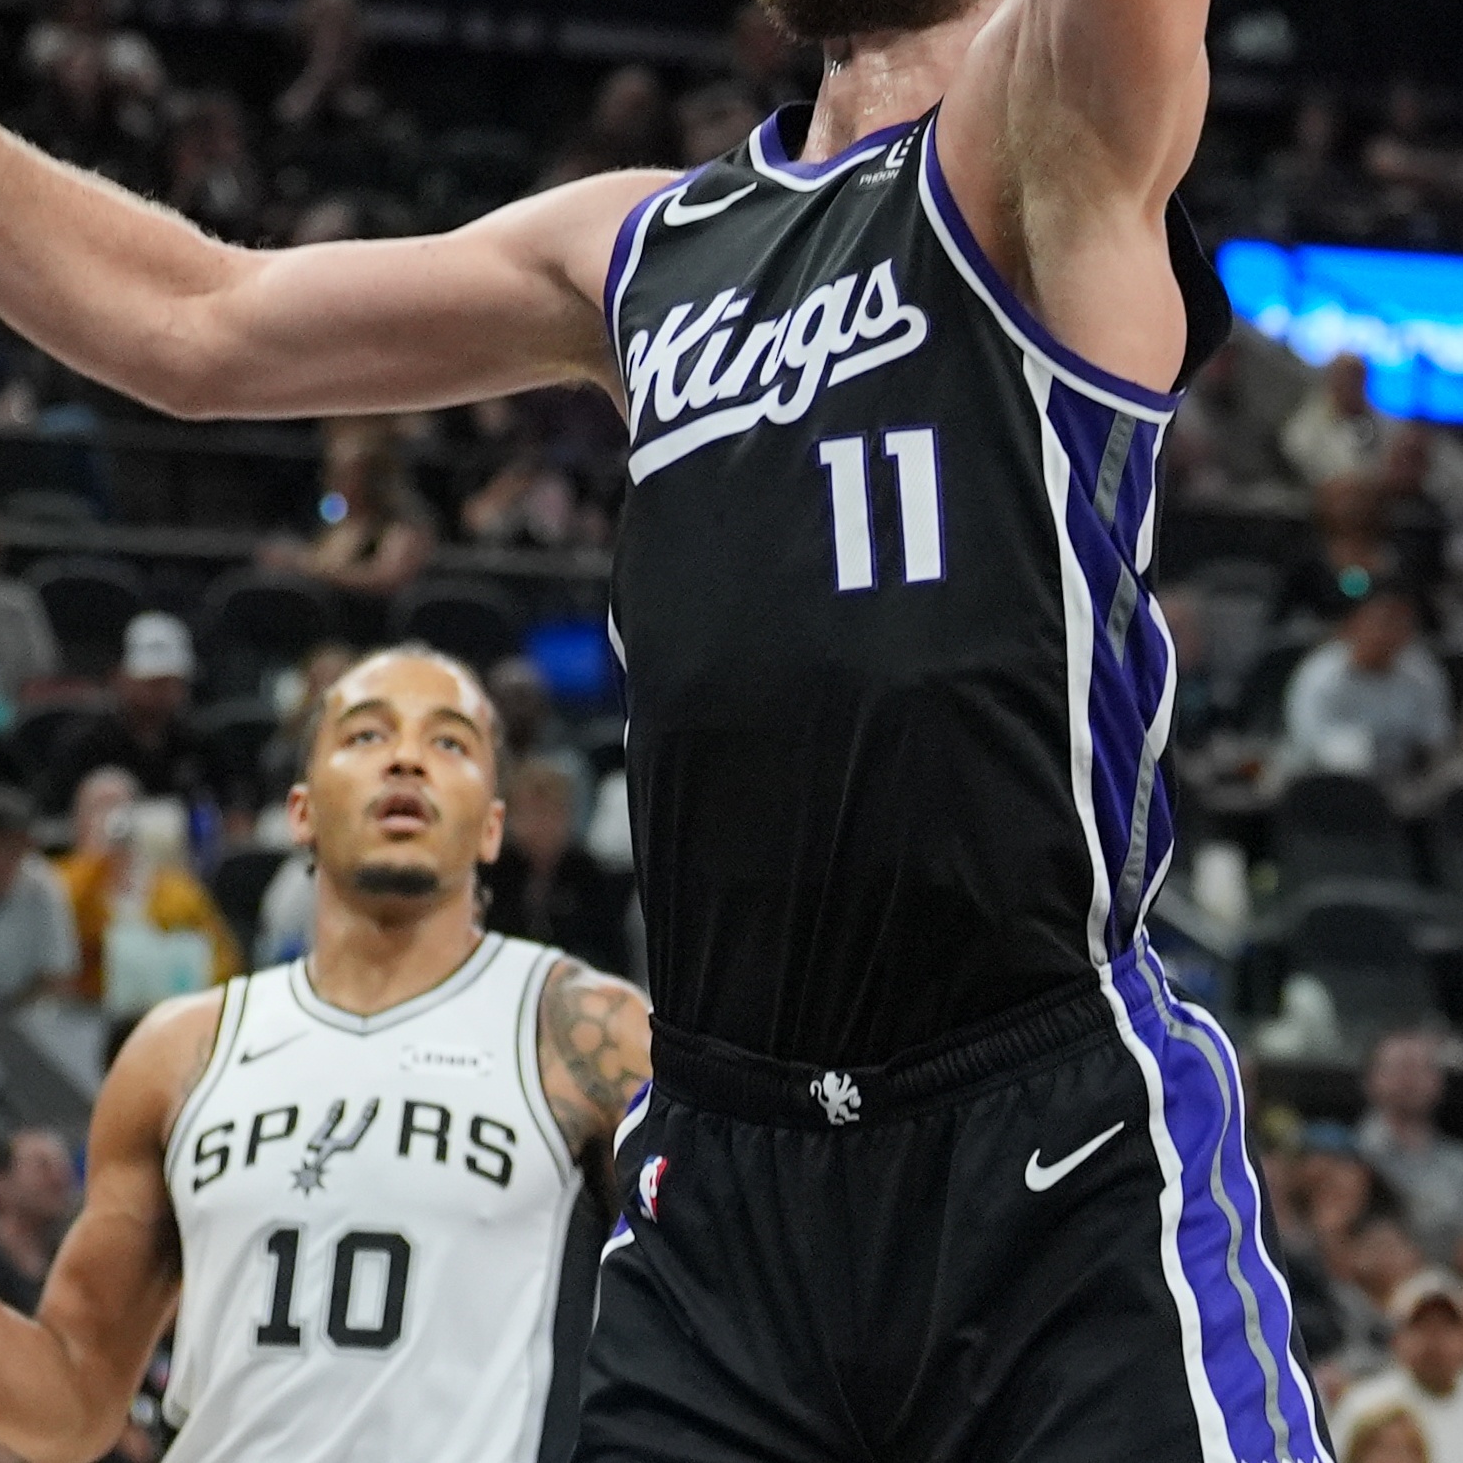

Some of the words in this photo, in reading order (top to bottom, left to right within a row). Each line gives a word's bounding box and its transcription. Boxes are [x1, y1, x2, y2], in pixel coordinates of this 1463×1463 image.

[626, 258, 928, 485] Kings
[818, 426, 944, 593] 11
[192, 1097, 518, 1198] SPURS
[256, 1226, 412, 1350] 10
